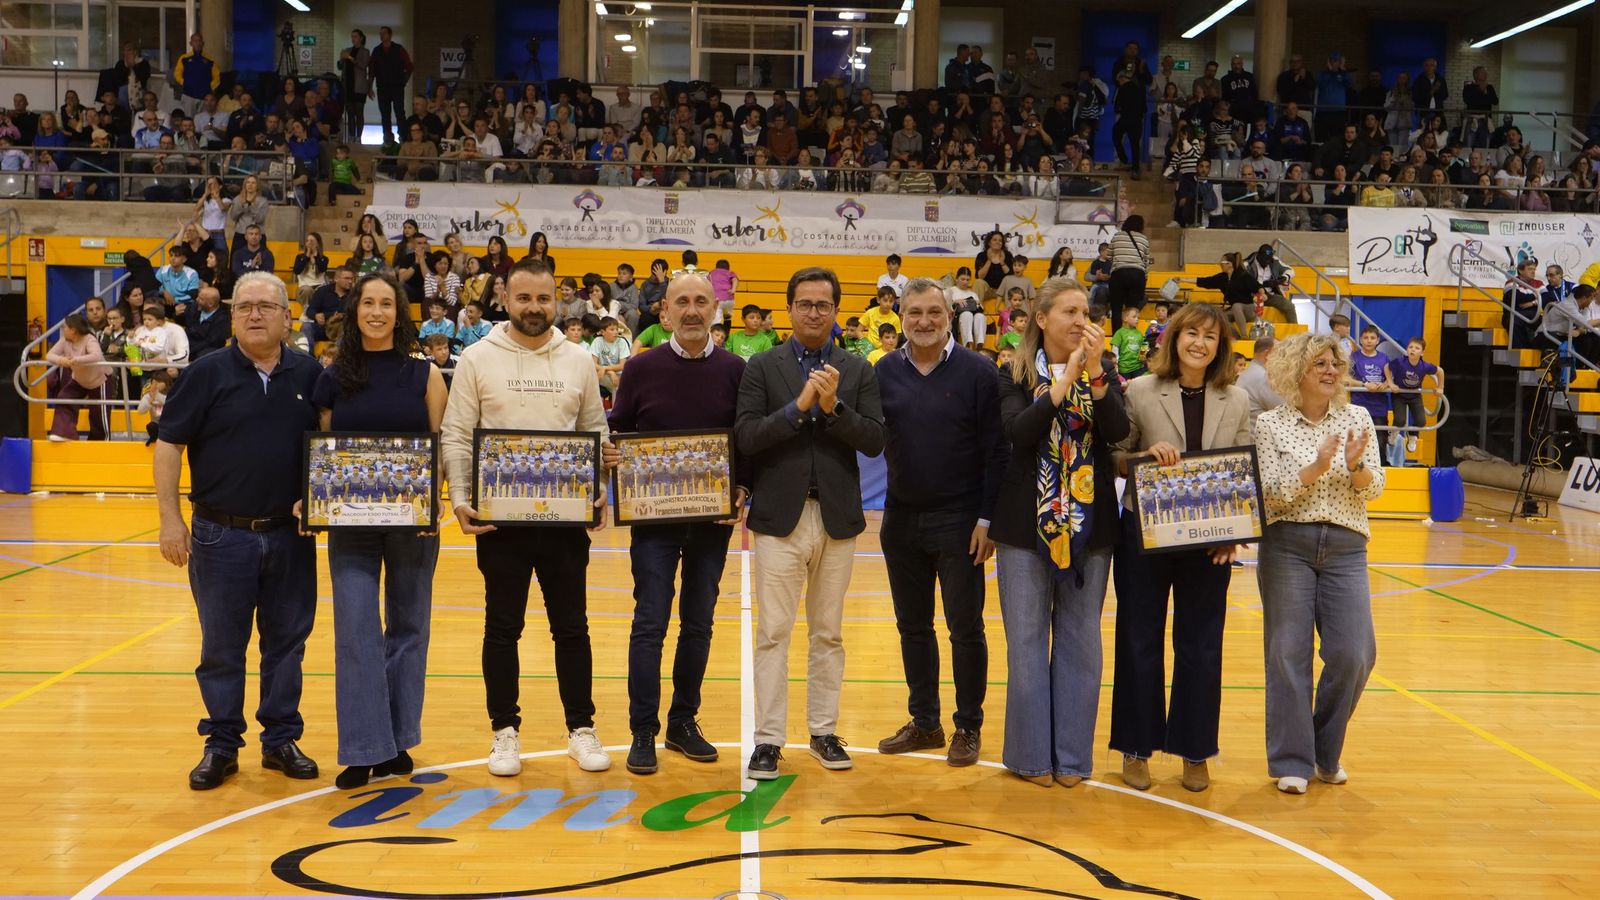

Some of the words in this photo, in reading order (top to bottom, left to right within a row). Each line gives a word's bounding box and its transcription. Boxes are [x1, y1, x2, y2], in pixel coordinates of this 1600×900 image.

[450, 210, 528, 236] sabores
[646, 217, 696, 226] DIPUTACIÓN
[1518, 222, 1565, 231] INDUSER
[646, 226, 657, 234] DE
[659, 226, 695, 235] ALMERÍA
[712, 215, 788, 241] sabores
[906, 225, 958, 234] DIPUTACIÓN
[907, 234, 919, 242] DE
[920, 234, 957, 243] ALMERÍA
[1394, 234, 1413, 256] GR
[655, 507, 682, 516] Francisco
[683, 506, 701, 514] Muñoz
[702, 505, 720, 513] Flores
[506, 511, 560, 521] surseeds
[1188, 526, 1234, 539] Bioline
